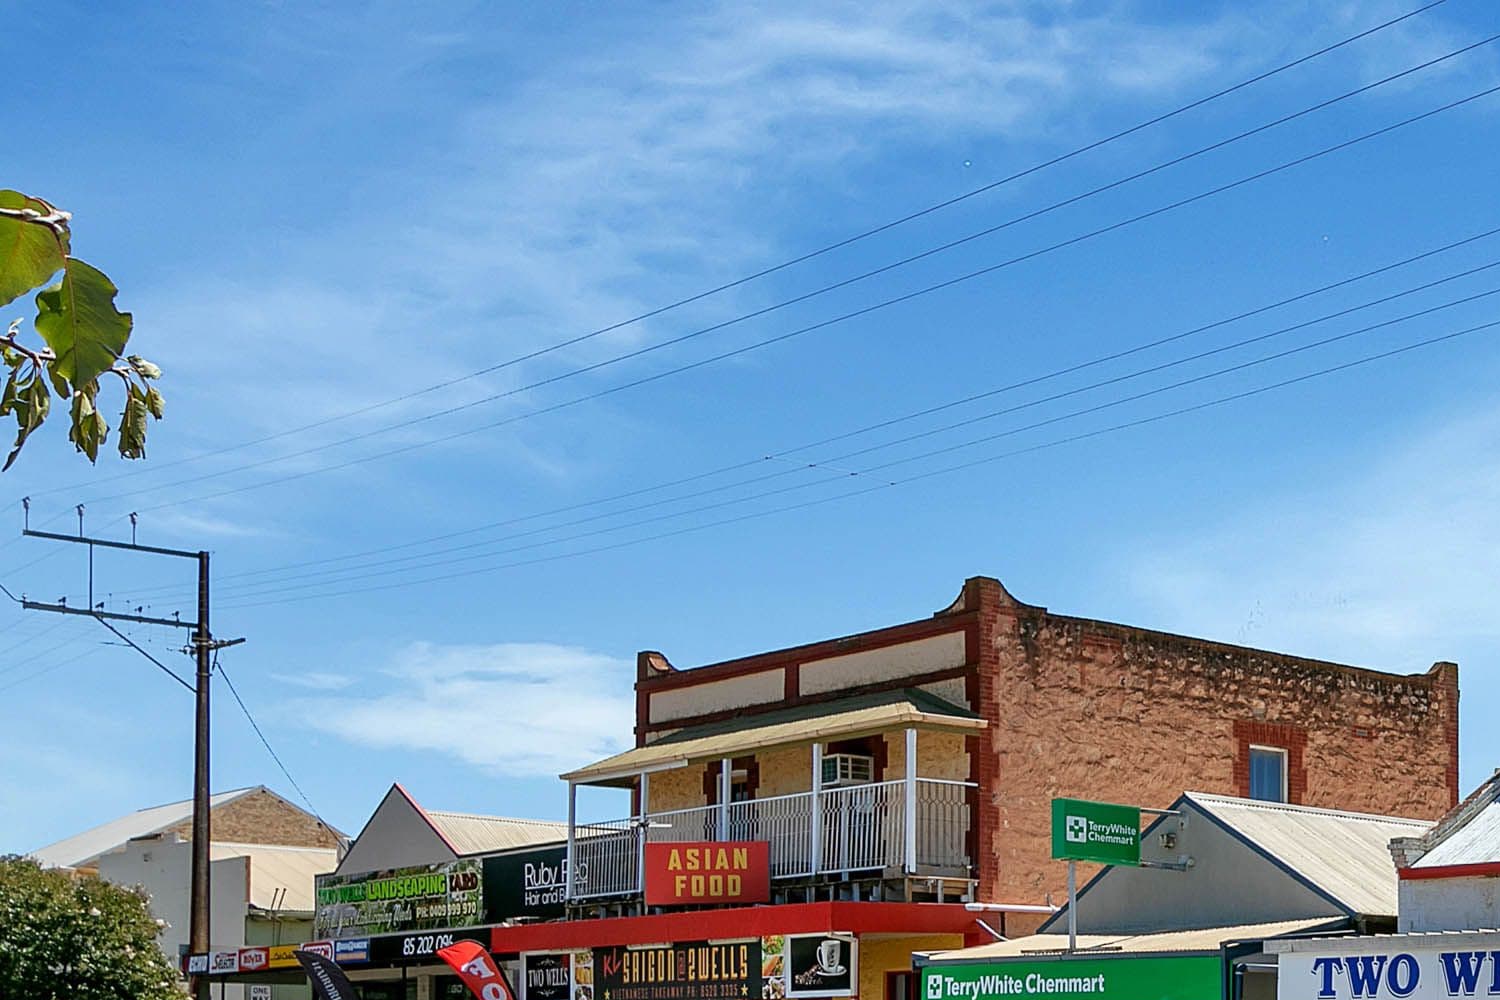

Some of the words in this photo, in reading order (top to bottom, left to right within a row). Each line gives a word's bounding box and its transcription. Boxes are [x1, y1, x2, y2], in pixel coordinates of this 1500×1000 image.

[1087, 821, 1137, 836] TerryWhite
[1087, 832, 1134, 846] Chemmart
[667, 847, 748, 871] ASIAN
[366, 874, 447, 900] LANDSCAPING
[525, 859, 559, 893] Ruby
[675, 873, 742, 897] FOOD
[525, 888, 542, 907] Hair
[542, 887, 559, 906] and
[403, 938, 415, 956] 85
[416, 936, 433, 955] 202
[528, 968, 545, 988] TWO
[545, 966, 569, 987] WELLS
[945, 974, 1023, 1000] TerryWhite
[1025, 973, 1105, 994] Chemmart
[1310, 952, 1421, 1000] TWO
[253, 986, 269, 995] ONE
